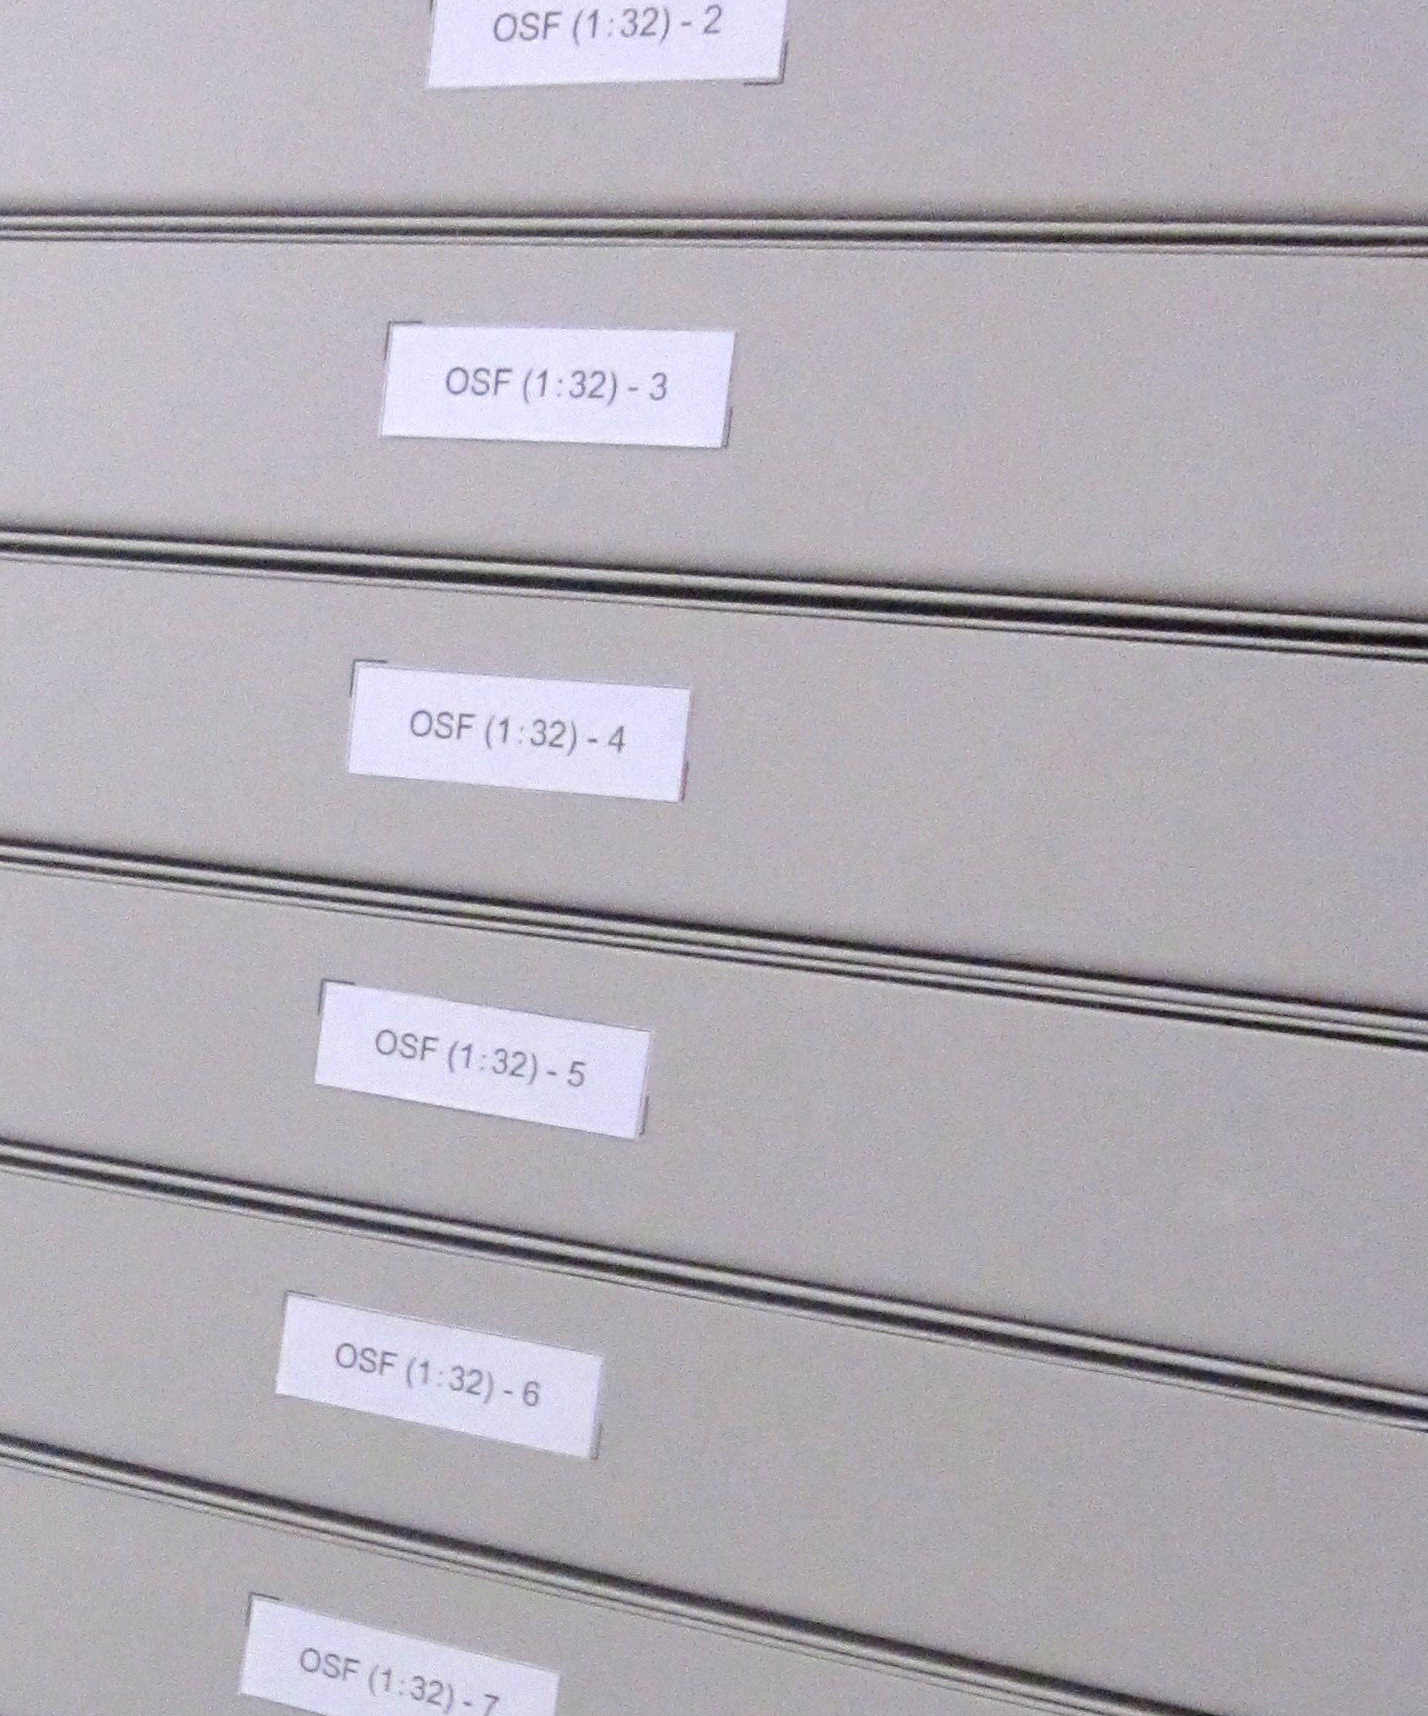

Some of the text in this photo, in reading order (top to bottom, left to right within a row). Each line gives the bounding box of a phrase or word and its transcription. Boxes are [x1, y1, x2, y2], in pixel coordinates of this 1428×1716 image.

[493, 11, 561, 42] OSF
[703, 5, 723, 35] 2
[445, 366, 512, 396] OSF
[649, 371, 668, 401] 3
[409, 710, 475, 740] OSF
[607, 725, 626, 752] 4
[375, 1029, 439, 1061] OSF
[566, 1061, 587, 1087] 5
[335, 1342, 398, 1376] OSF
[522, 1381, 540, 1406] 6
[299, 1647, 361, 1681] OSF
